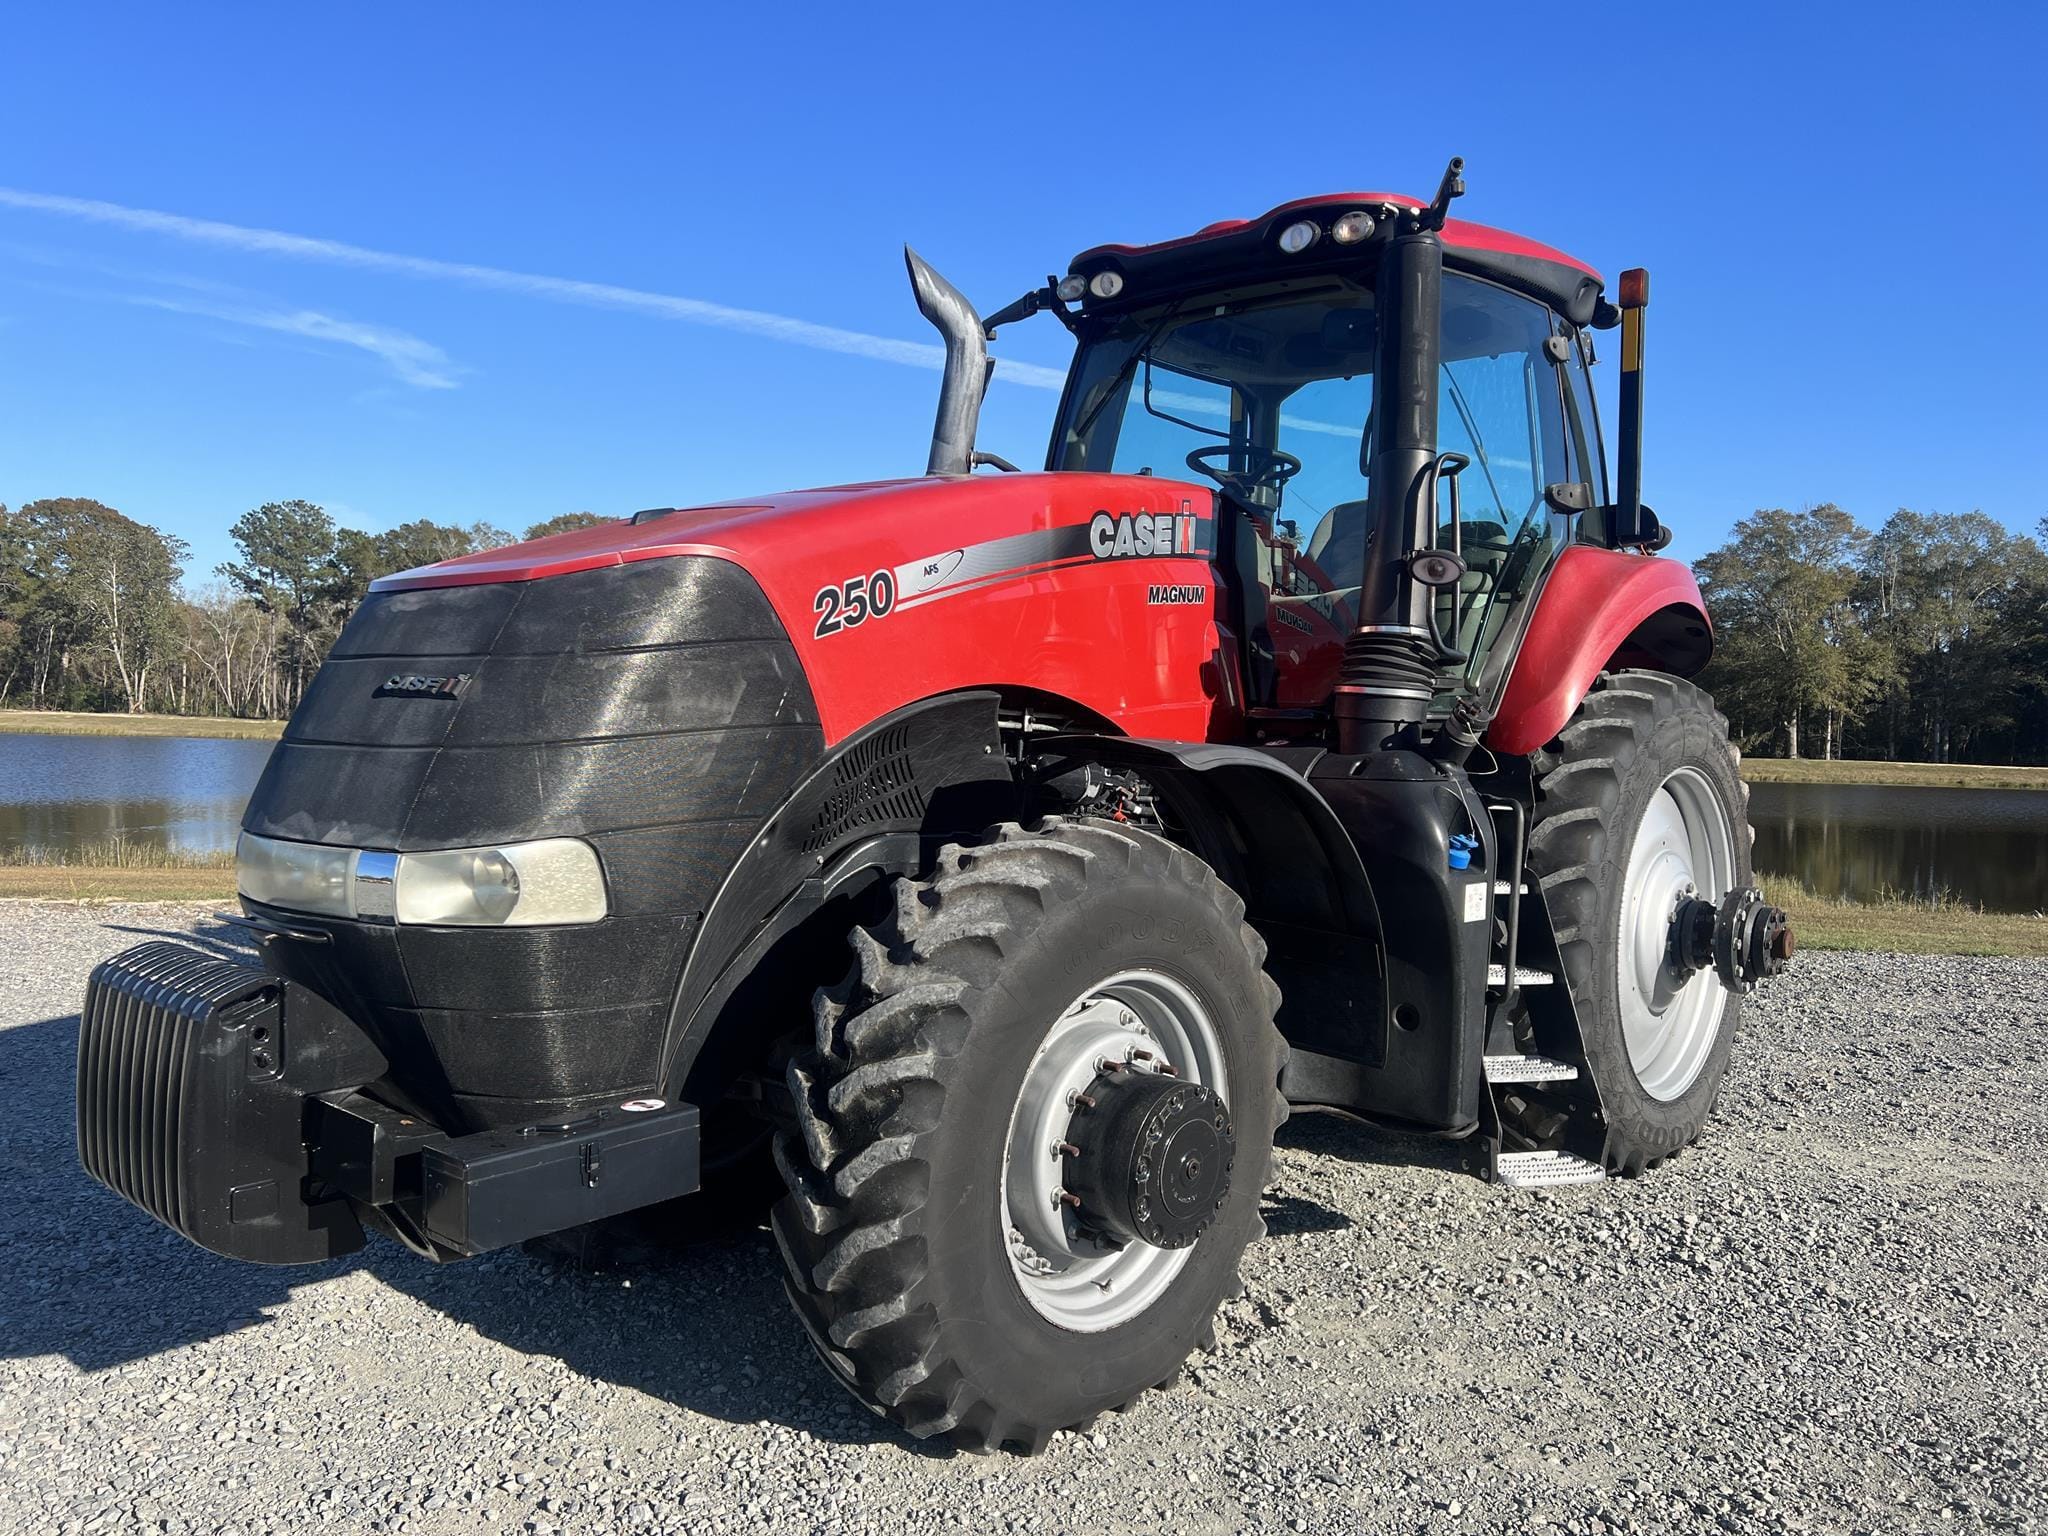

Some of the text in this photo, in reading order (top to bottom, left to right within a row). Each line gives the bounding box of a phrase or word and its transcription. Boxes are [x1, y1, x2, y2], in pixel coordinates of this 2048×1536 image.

[923, 563, 940, 577] AFS
[814, 569, 894, 639] 250
[1148, 585, 1205, 604] MAGNUM
